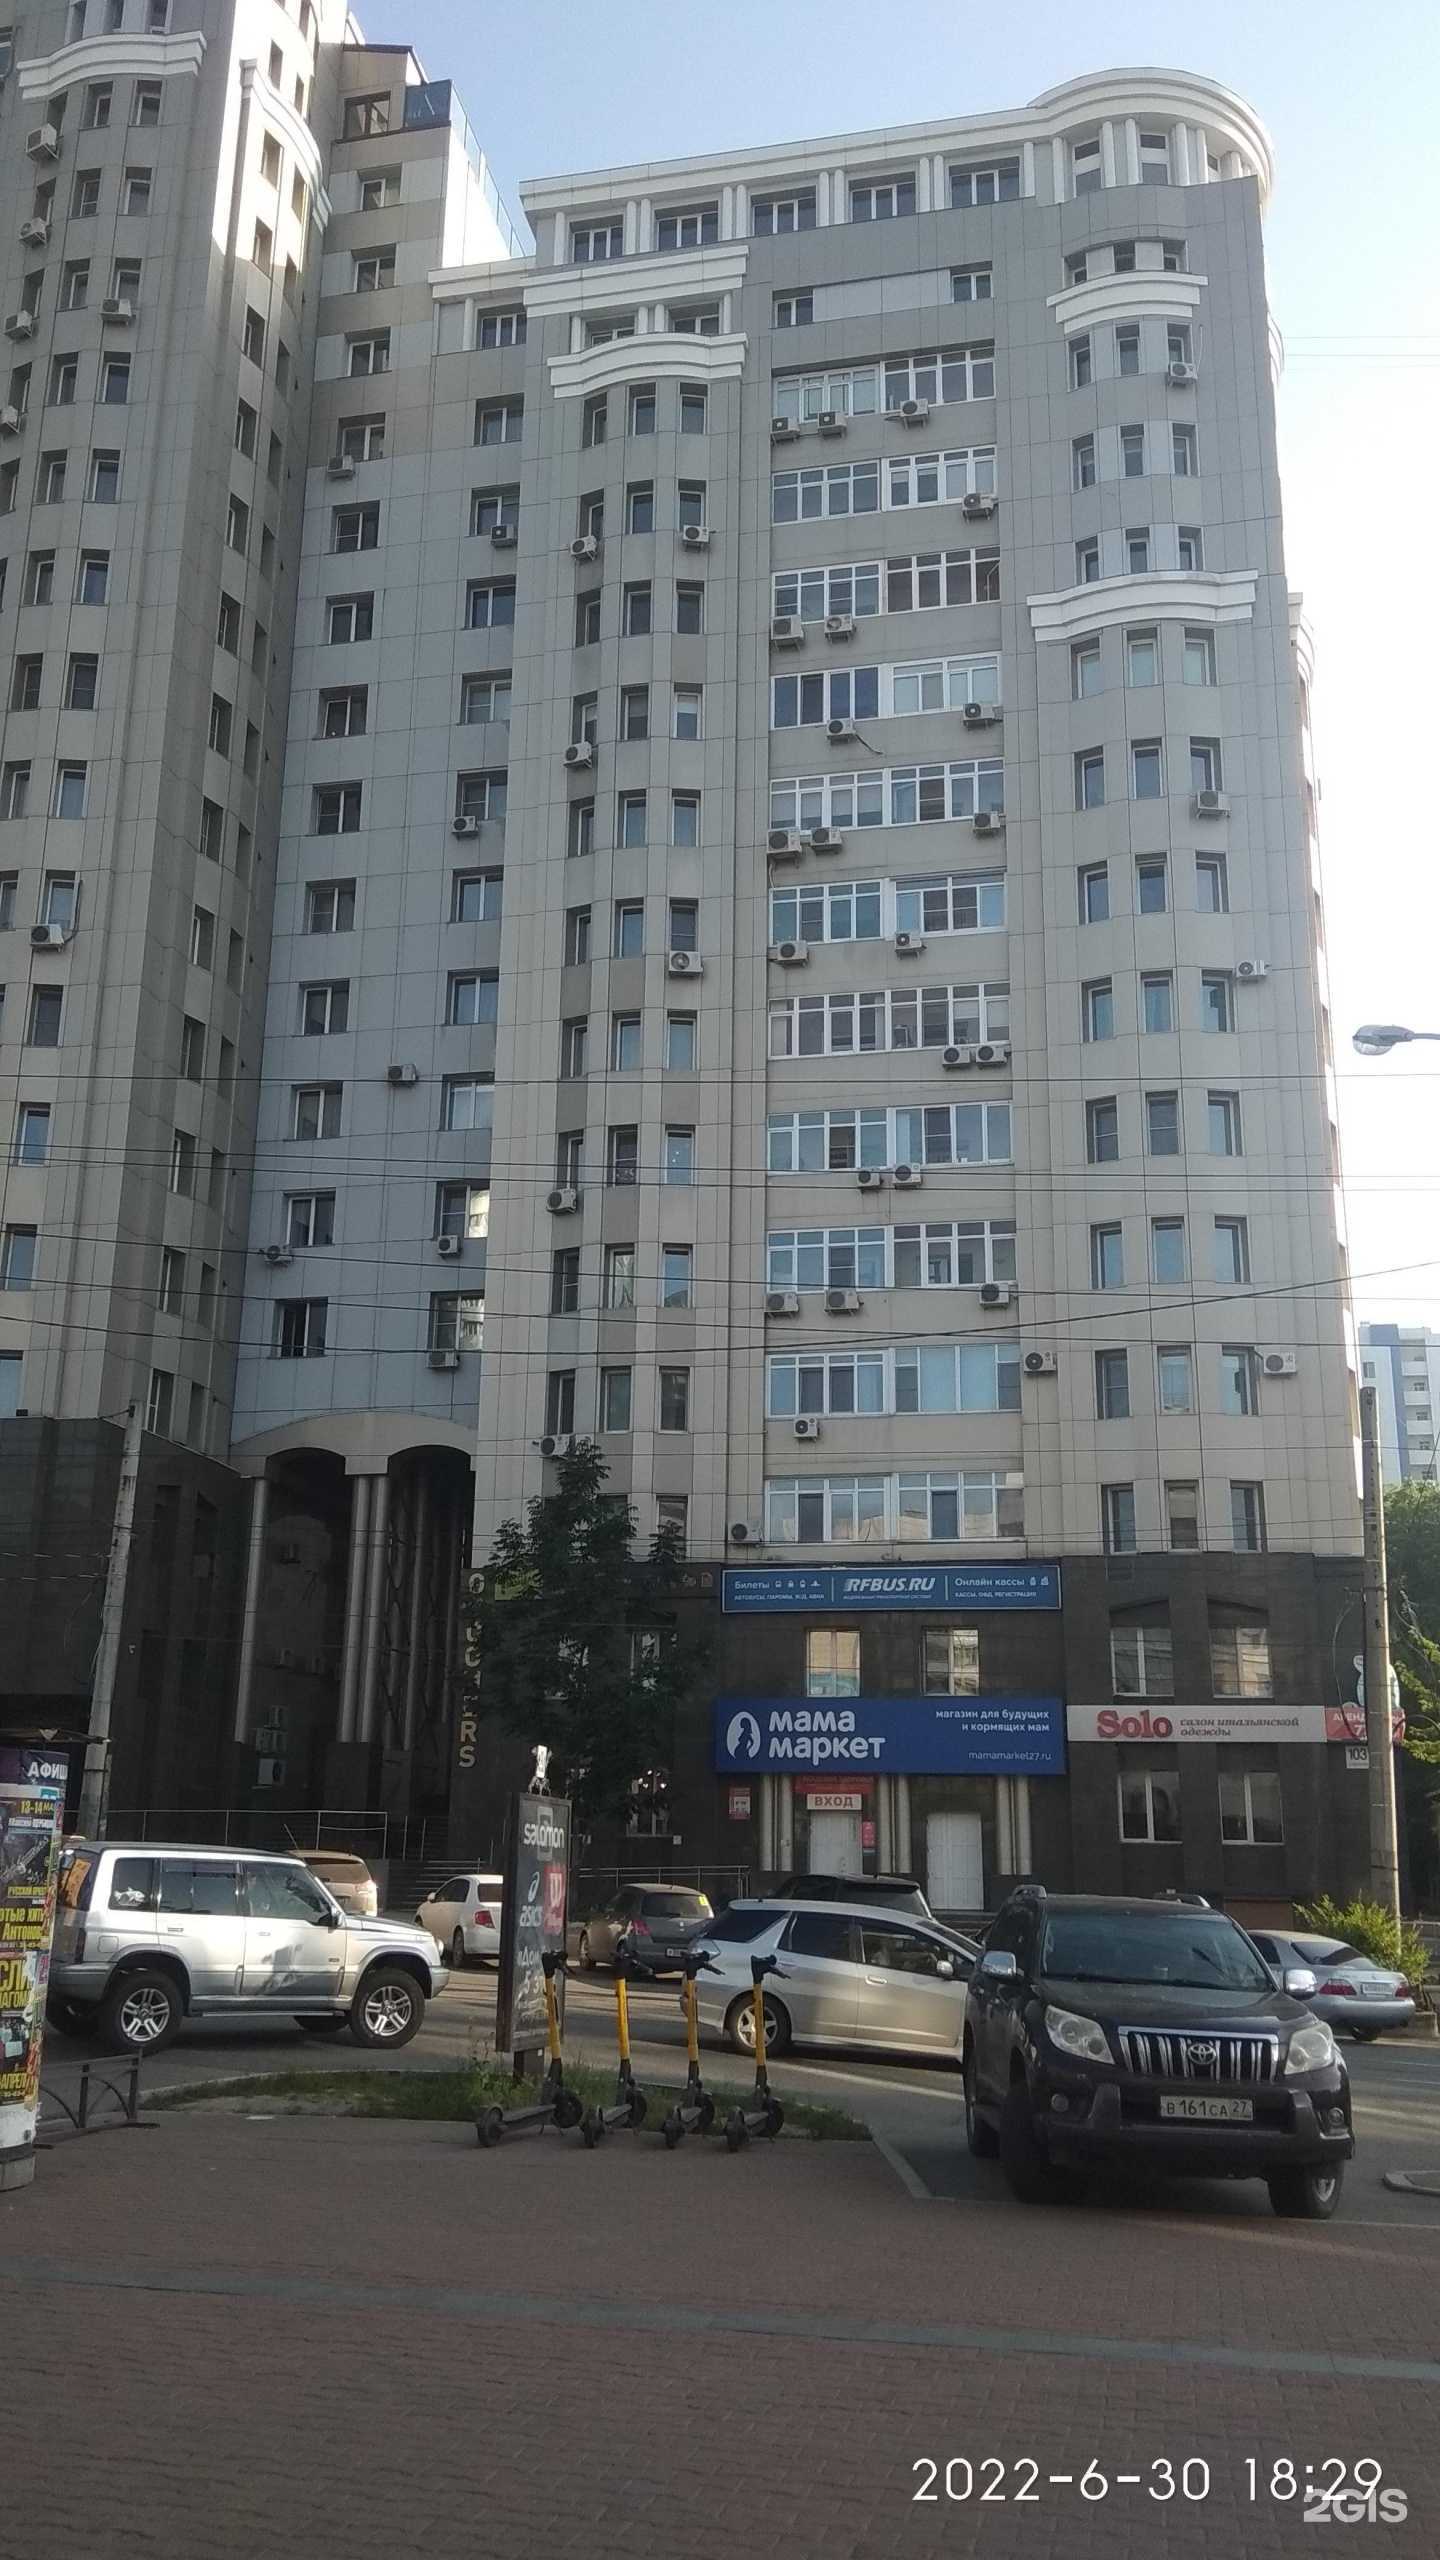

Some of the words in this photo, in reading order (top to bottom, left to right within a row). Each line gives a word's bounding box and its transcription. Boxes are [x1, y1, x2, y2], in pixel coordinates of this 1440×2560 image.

[734, 1580, 770, 1590] Билеты
[844, 1577, 936, 1593] RFBUS.RU
[954, 1576, 993, 1587] Онлайн
[994, 1577, 1025, 1586] кассы
[935, 1710, 978, 1719] магазин
[981, 1710, 1000, 1720] для
[1002, 1709, 1050, 1721] будущих
[768, 1710, 856, 1733] мама
[1096, 1709, 1173, 1739] Solo
[1180, 1718, 1214, 1727] салон
[1216, 1716, 1300, 1727] итальянской
[961, 1723, 969, 1731] и
[971, 1723, 1025, 1733] кормящих
[1027, 1723, 1050, 1732] мам
[1180, 1727, 1231, 1737] одежды
[768, 1736, 886, 1766] маркет
[968, 1750, 1052, 1761] mamamarket27.ru
[1348, 1747, 1368, 1761] 103
[814, 1796, 854, 1808] ВХОД
[523, 1822, 565, 1849] salomon
[519, 1904, 542, 1927] asics
[1232, 2100, 1247, 2113] 27
